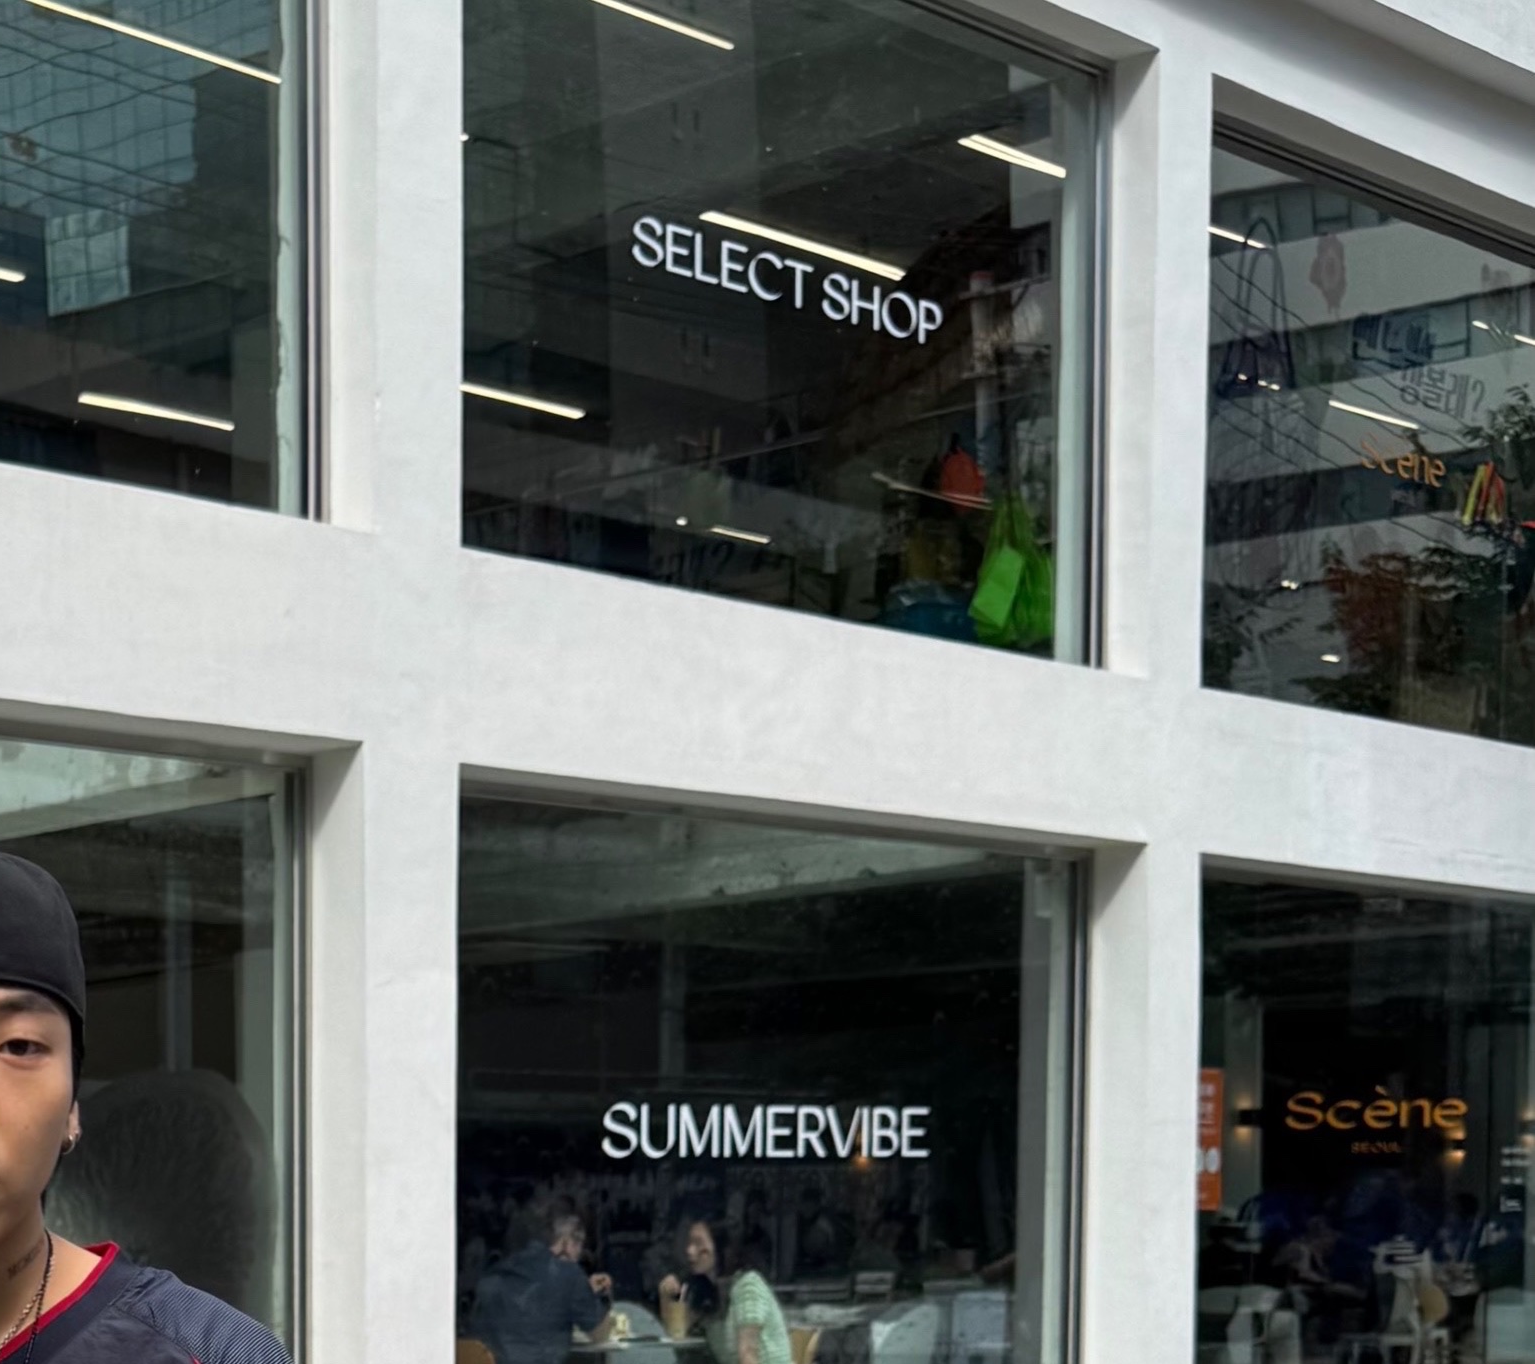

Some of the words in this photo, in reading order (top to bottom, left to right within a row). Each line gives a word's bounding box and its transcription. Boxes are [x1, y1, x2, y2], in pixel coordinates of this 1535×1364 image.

[631, 215, 815, 310] SELECT
[821, 272, 944, 345] SHOP
[601, 1101, 931, 1160] SUMMERVIBE
[1285, 1085, 1469, 1131] Scène
